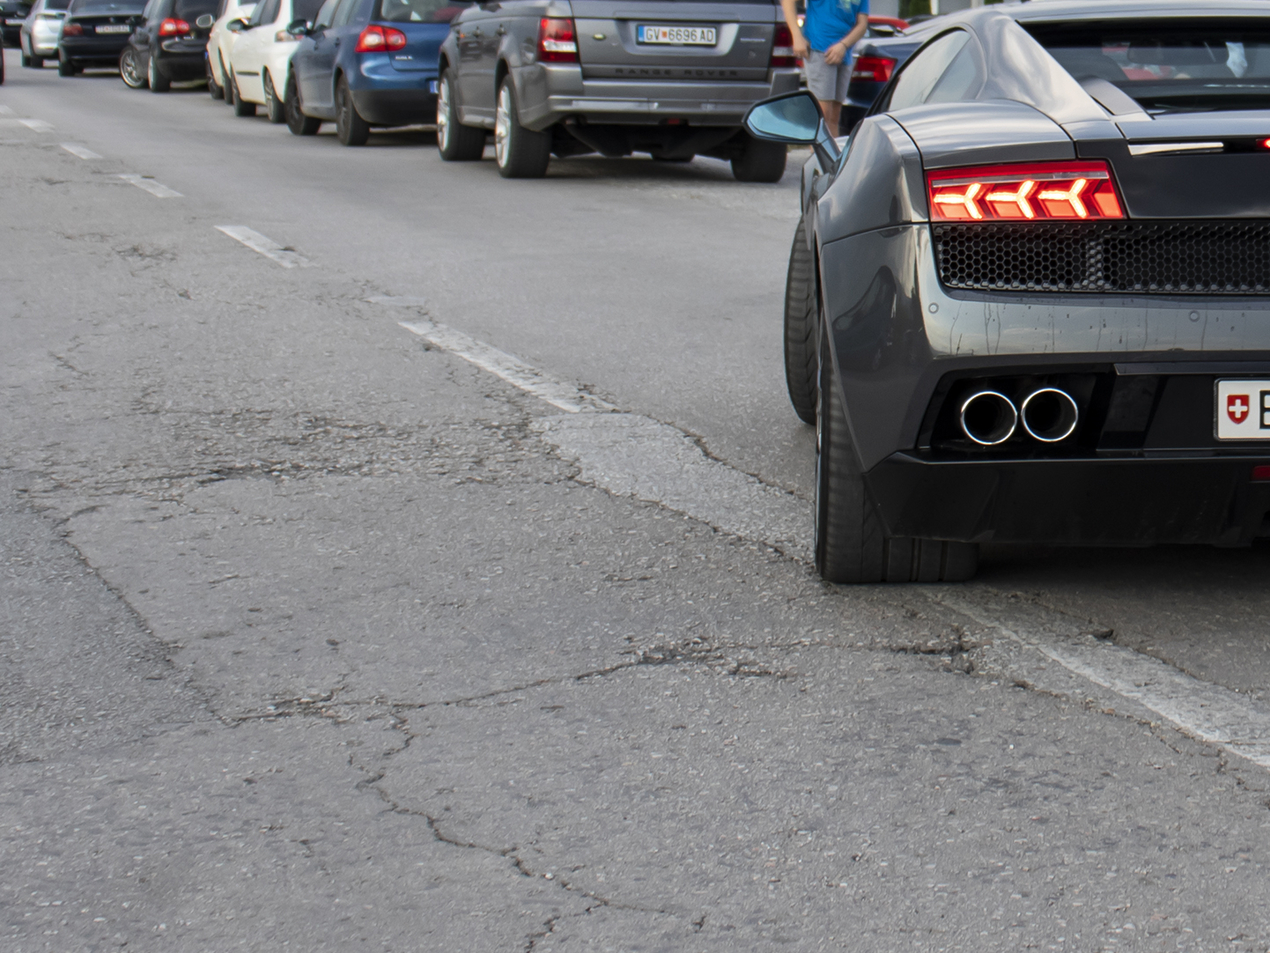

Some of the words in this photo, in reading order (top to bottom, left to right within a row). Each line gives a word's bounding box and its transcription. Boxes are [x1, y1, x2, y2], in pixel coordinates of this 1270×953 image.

[646, 28, 661, 40] GV
[668, 28, 698, 41] 6696
[700, 30, 714, 42] AD
[615, 68, 672, 76] RANGE
[684, 69, 738, 77] ROVER
